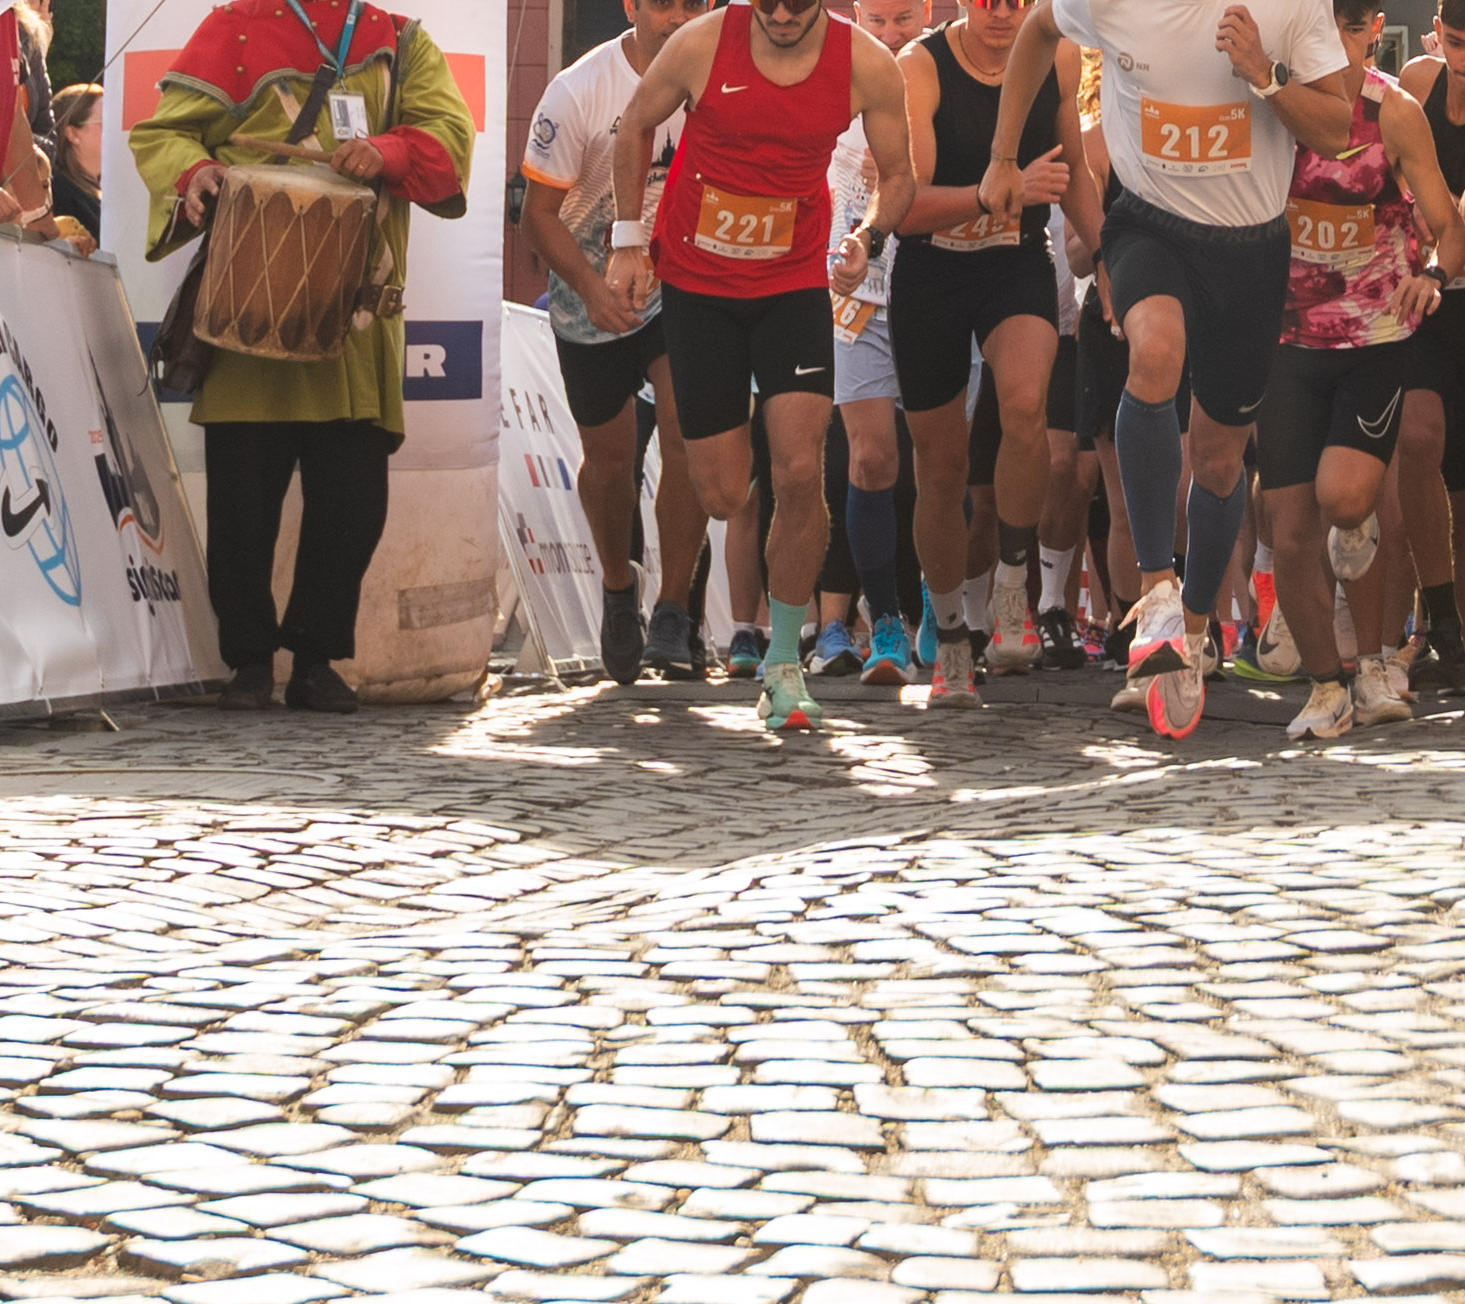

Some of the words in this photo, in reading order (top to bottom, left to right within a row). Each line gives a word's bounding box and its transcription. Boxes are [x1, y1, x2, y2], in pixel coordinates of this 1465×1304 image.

[1160, 123, 1229, 159] 212
[715, 209, 775, 243] 221
[1297, 215, 1360, 249] 202
